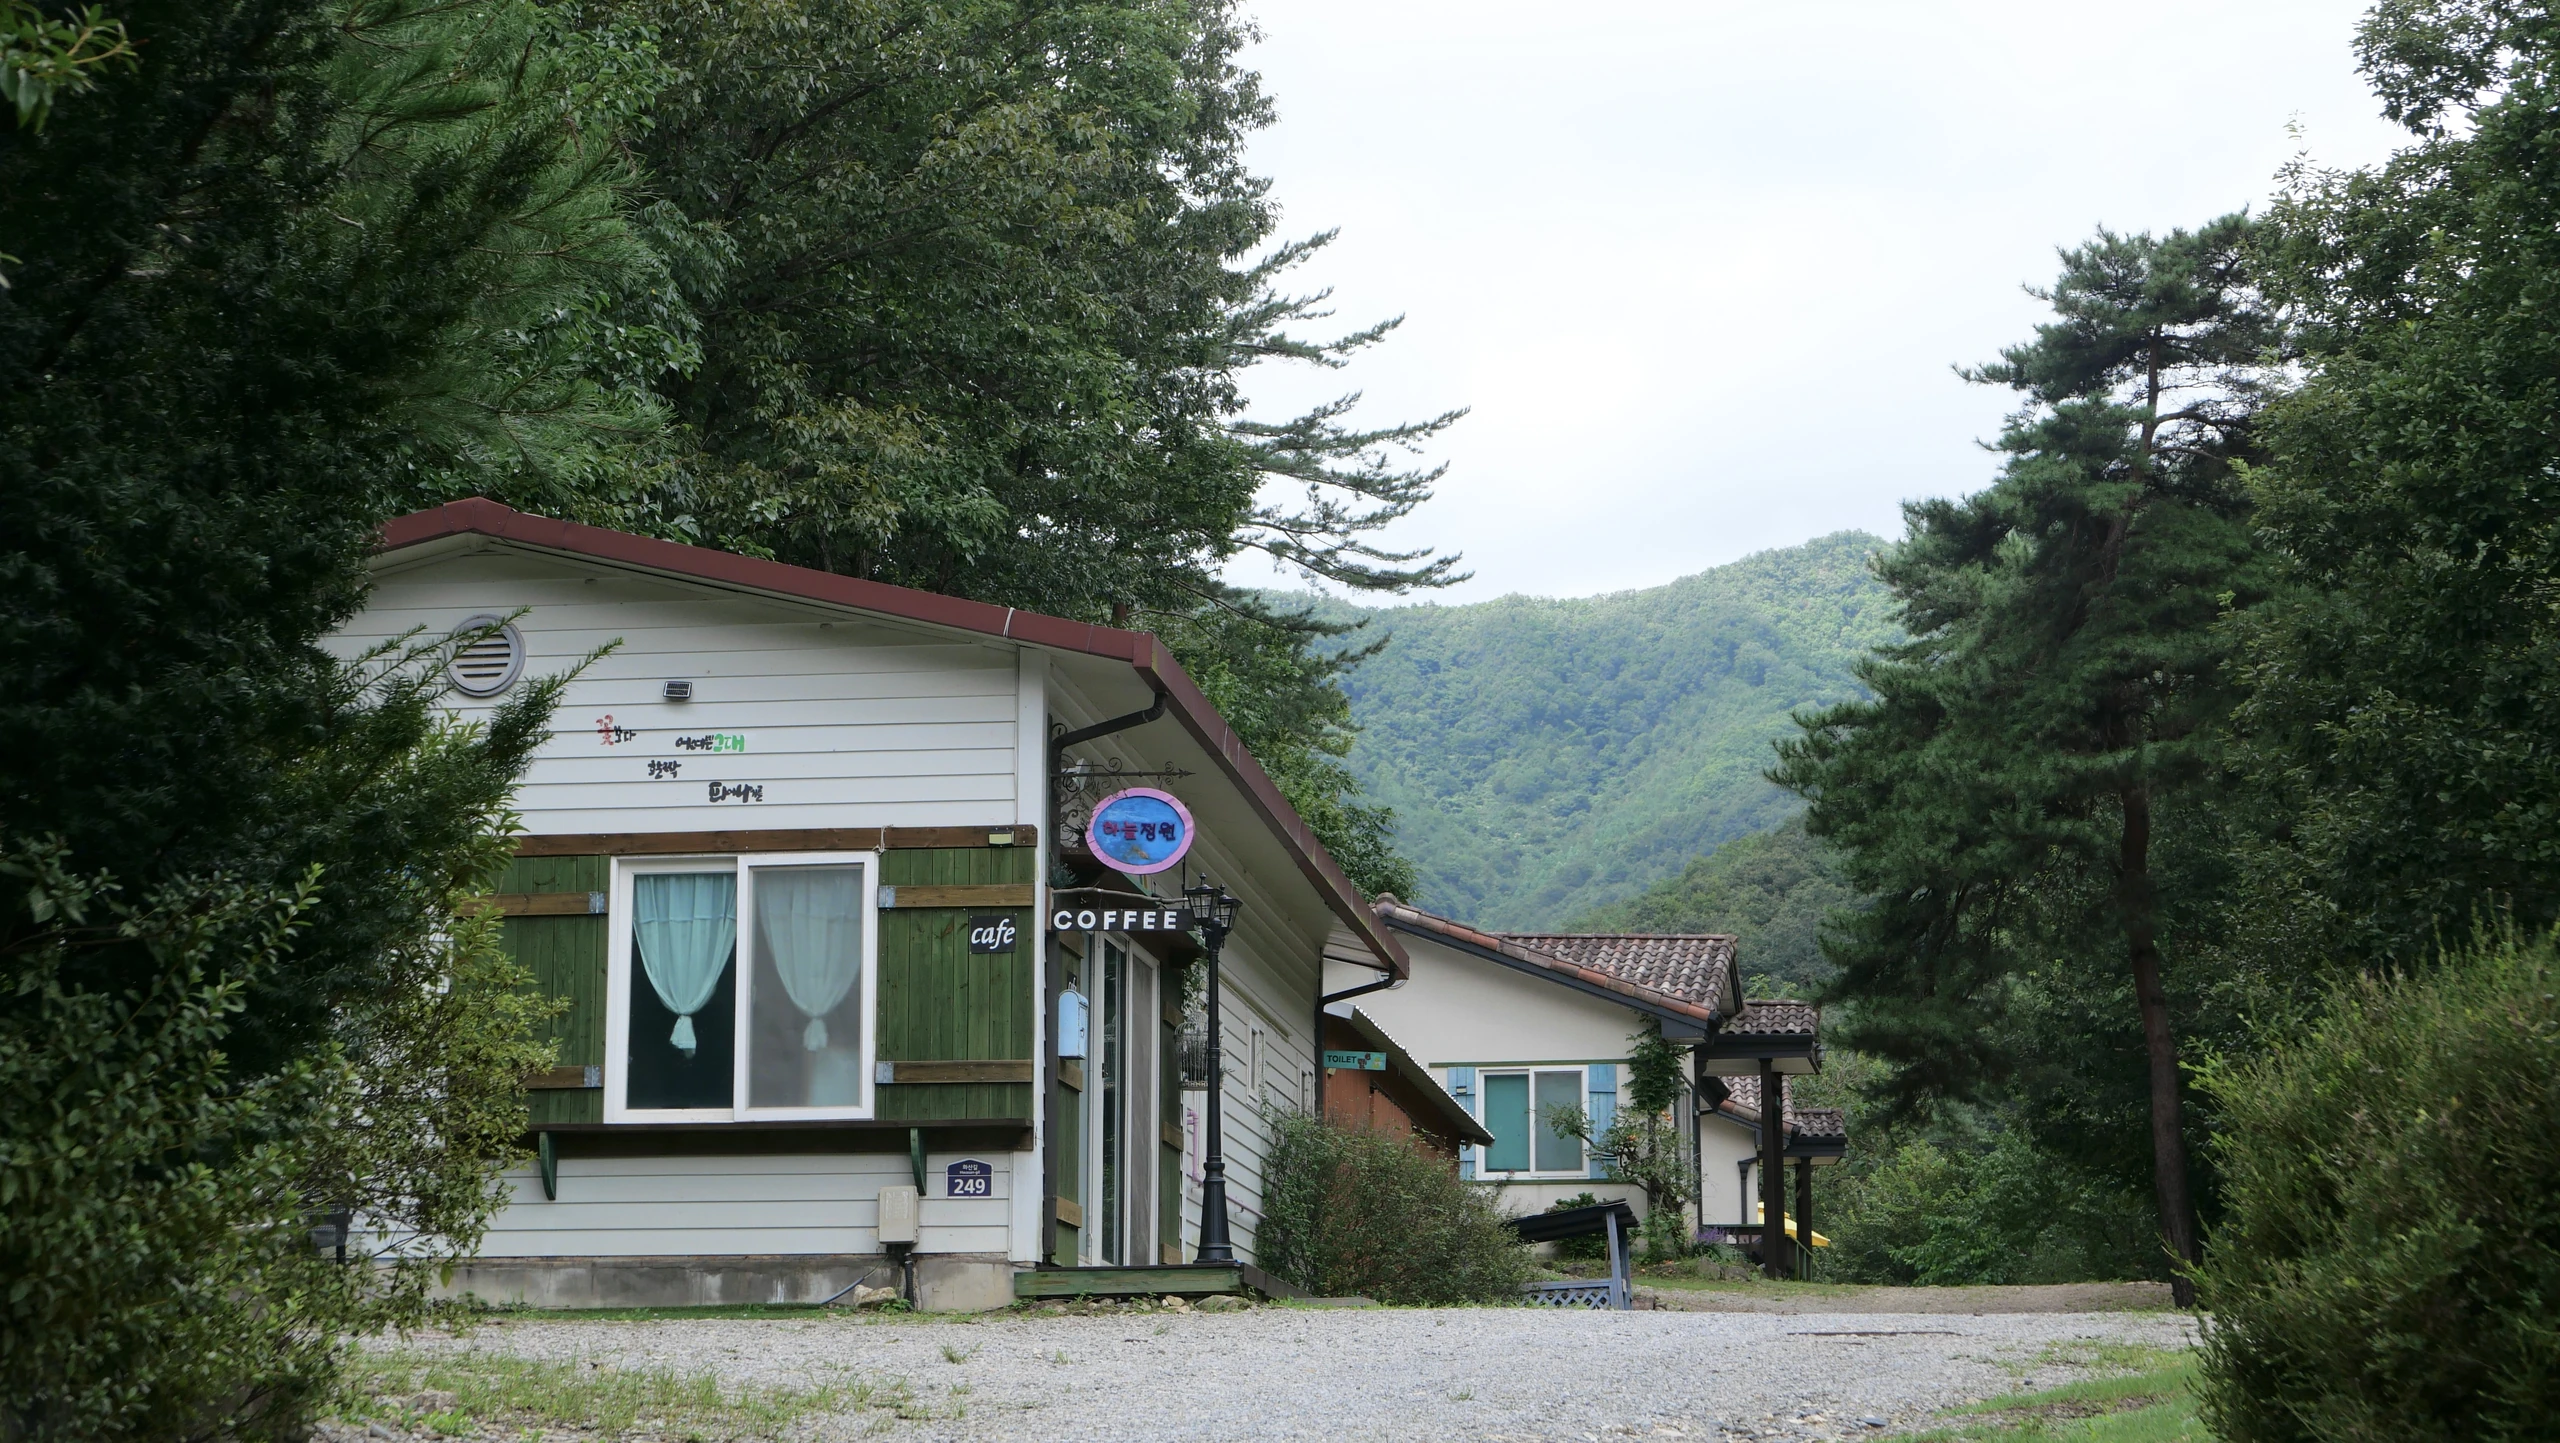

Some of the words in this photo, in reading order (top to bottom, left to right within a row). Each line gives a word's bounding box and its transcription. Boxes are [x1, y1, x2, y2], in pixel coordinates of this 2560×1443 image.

[713, 733, 745, 752] 그대
[1102, 820, 1175, 842] 하늘정원
[1053, 910, 1178, 930] COFFEE
[970, 918, 1016, 949] cafe
[1327, 1055, 1357, 1064] TOILET
[953, 1178, 986, 1194] 249
